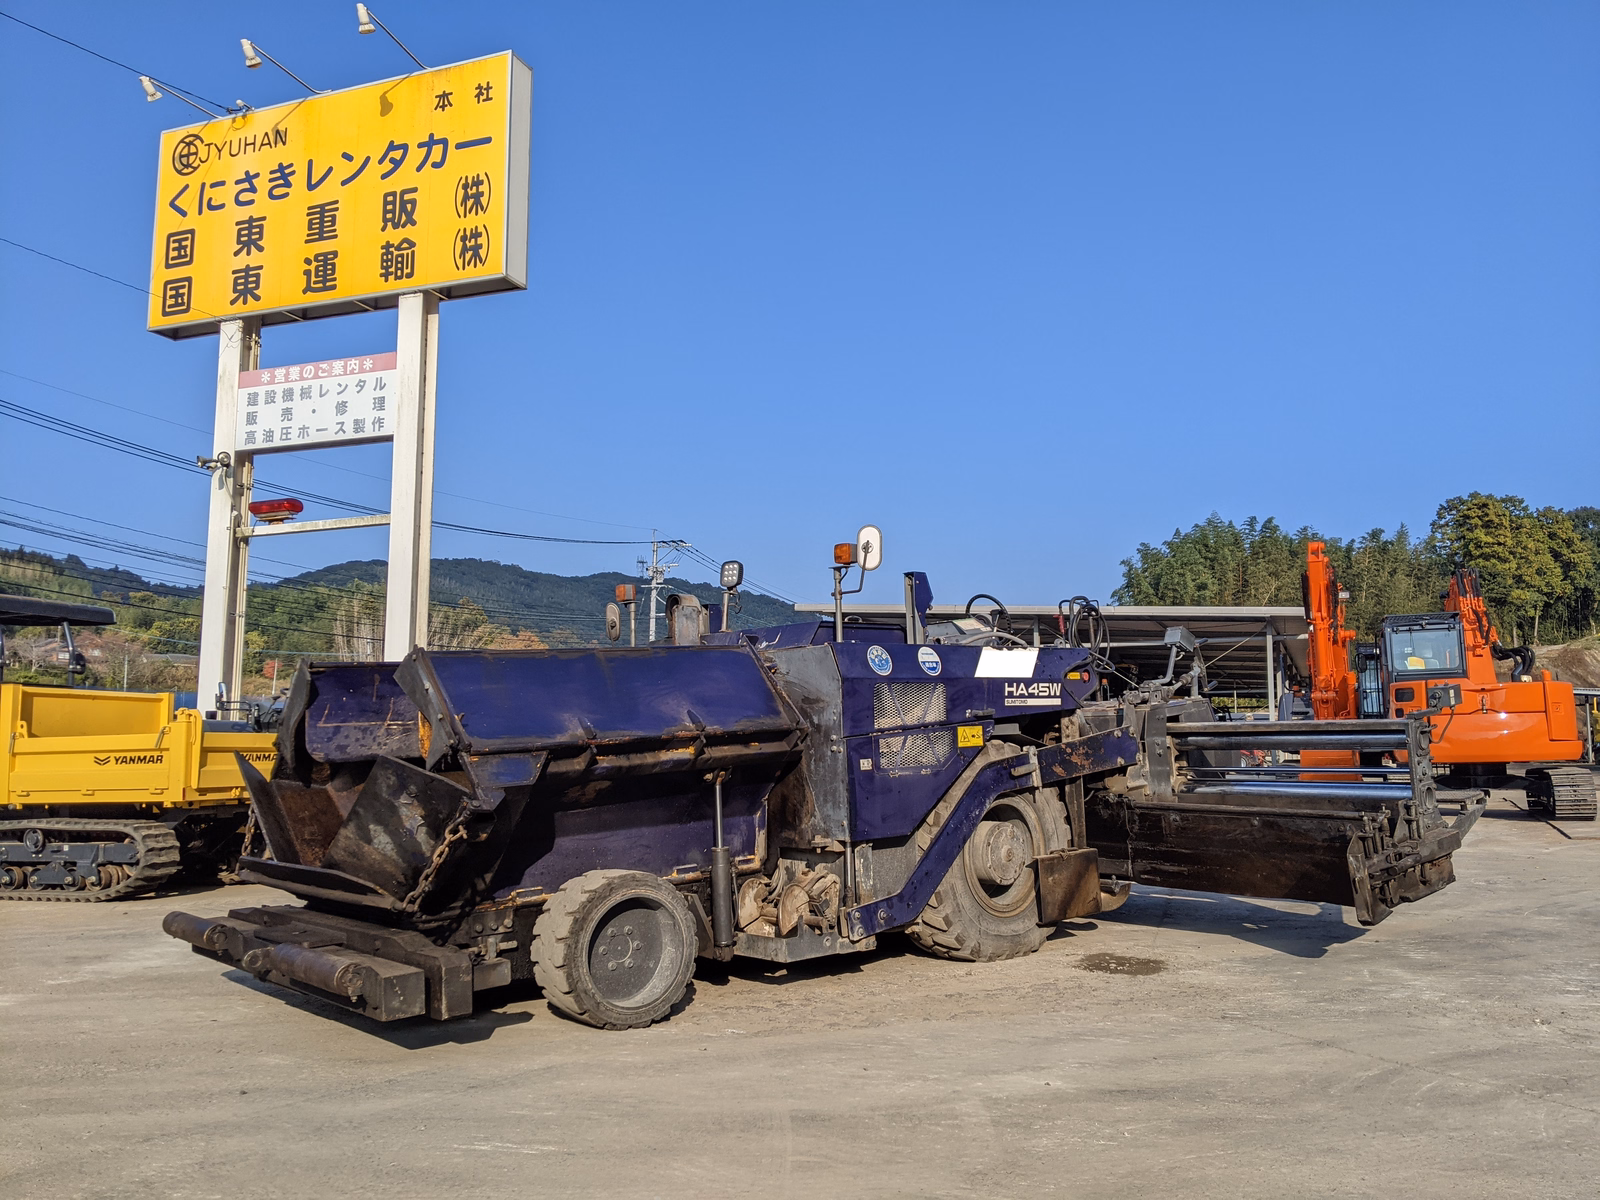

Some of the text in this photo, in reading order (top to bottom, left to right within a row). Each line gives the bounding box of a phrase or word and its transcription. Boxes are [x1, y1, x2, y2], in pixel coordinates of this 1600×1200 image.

[434, 81, 494, 112] 本社
[199, 127, 288, 164] JYUHAN
[168, 132, 493, 218] くにさきレンタカー
[246, 376, 387, 407] 建設機械レンタル
[244, 416, 385, 446] 高油圧ホース製作
[1004, 682, 1062, 696] HA45W
[113, 755, 164, 765] YANMAR
[241, 753, 278, 762] YANMA
